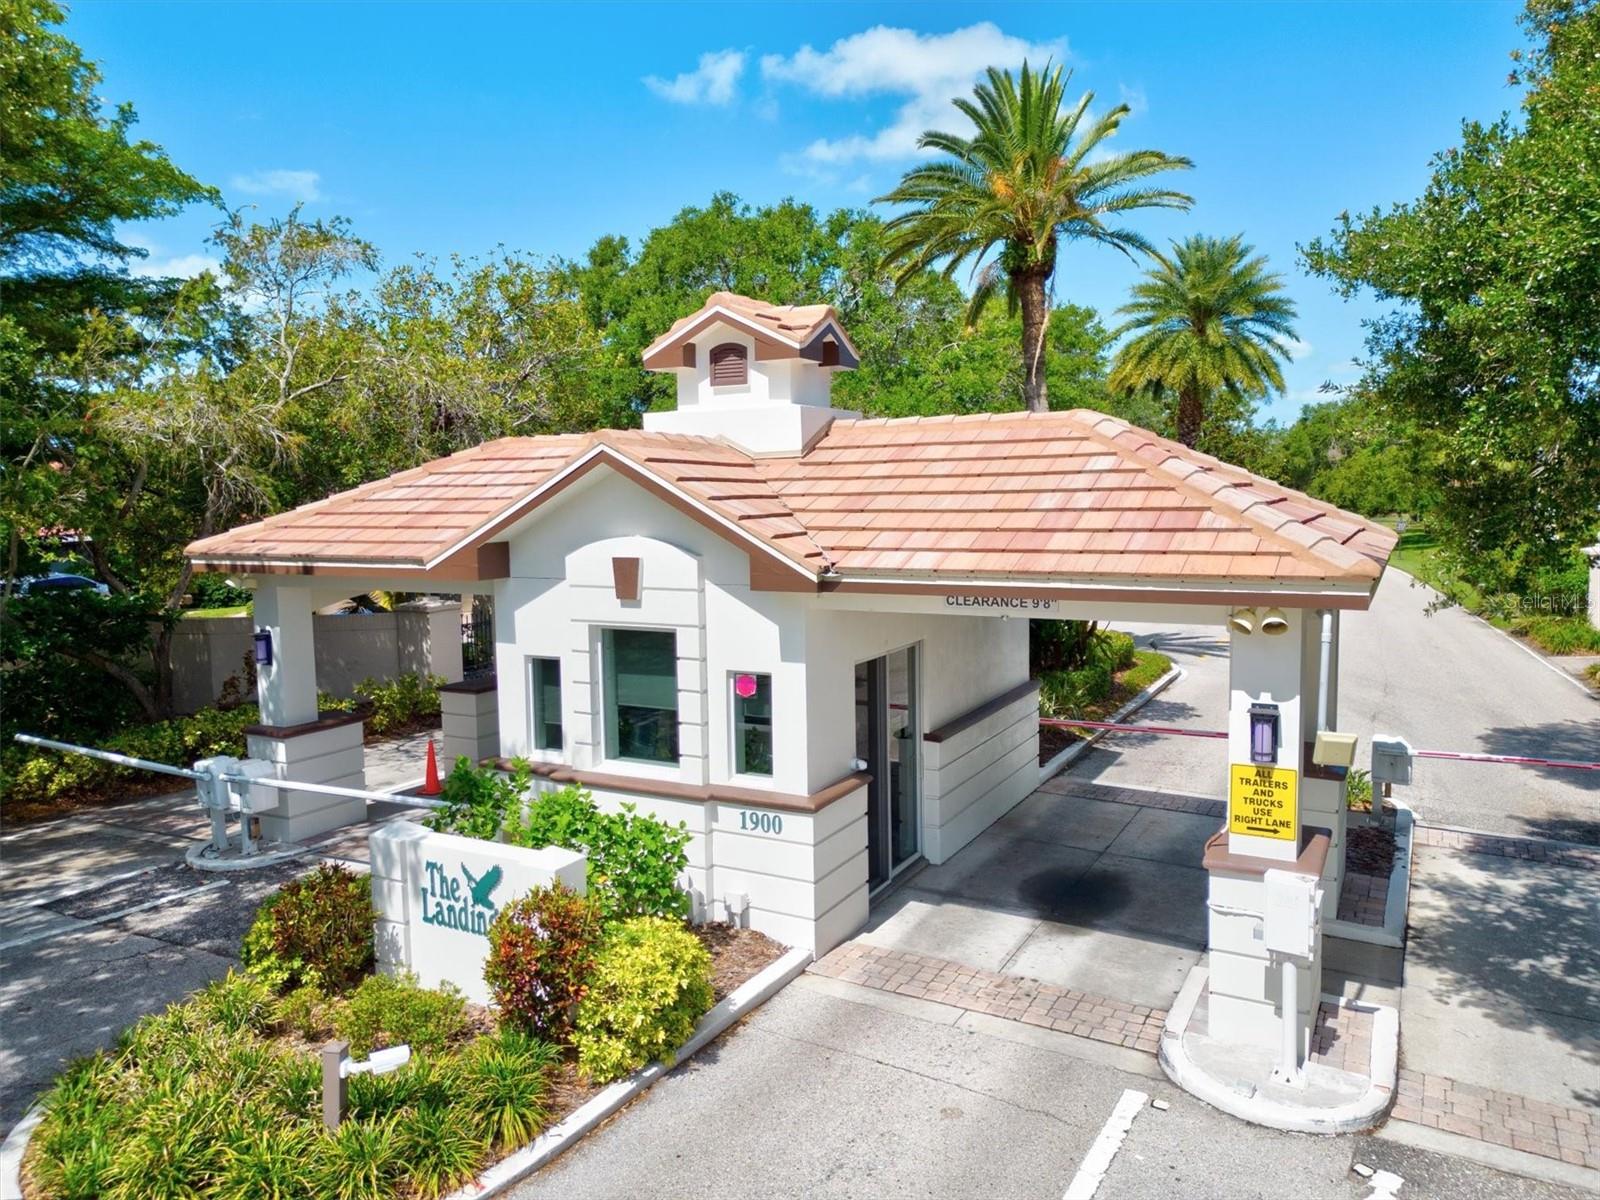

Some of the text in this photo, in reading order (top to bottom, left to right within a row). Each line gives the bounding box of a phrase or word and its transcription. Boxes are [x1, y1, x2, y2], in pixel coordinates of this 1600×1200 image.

[946, 595, 1028, 608] CLEARANCE
[1254, 770, 1273, 779] ALL
[1239, 777, 1289, 790] TRAILERS
[1252, 788, 1274, 798] AND
[1243, 797, 1283, 809] TRUCKS
[1252, 808, 1273, 817] USE
[740, 811, 783, 835] 1900
[1234, 815, 1292, 829] RIGHT LANE
[425, 860, 461, 902] The
